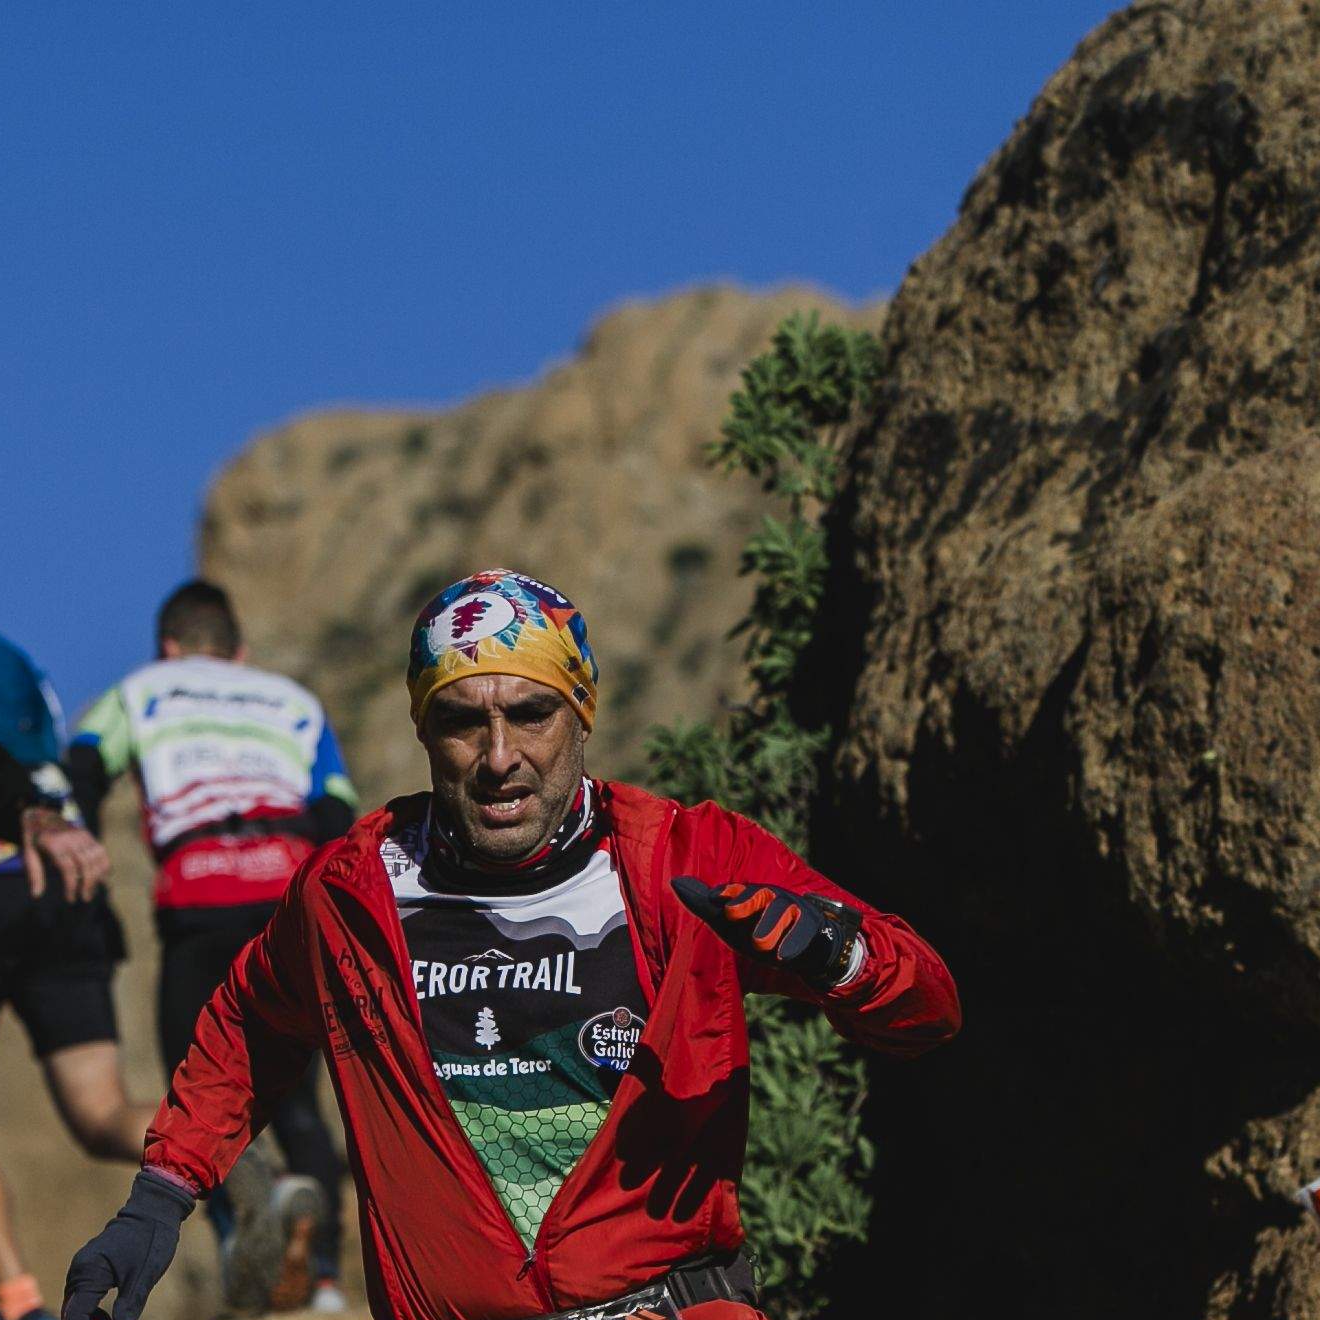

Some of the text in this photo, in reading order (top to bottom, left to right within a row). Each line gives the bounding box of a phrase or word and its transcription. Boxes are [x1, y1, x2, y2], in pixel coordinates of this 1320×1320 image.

[410, 960, 490, 1000] EROR
[497, 951, 582, 995] TRAIL
[592, 1023, 640, 1043] Estrell
[594, 1040, 635, 1059] Galici
[483, 1059, 507, 1077] de
[509, 1058, 552, 1075] Teror
